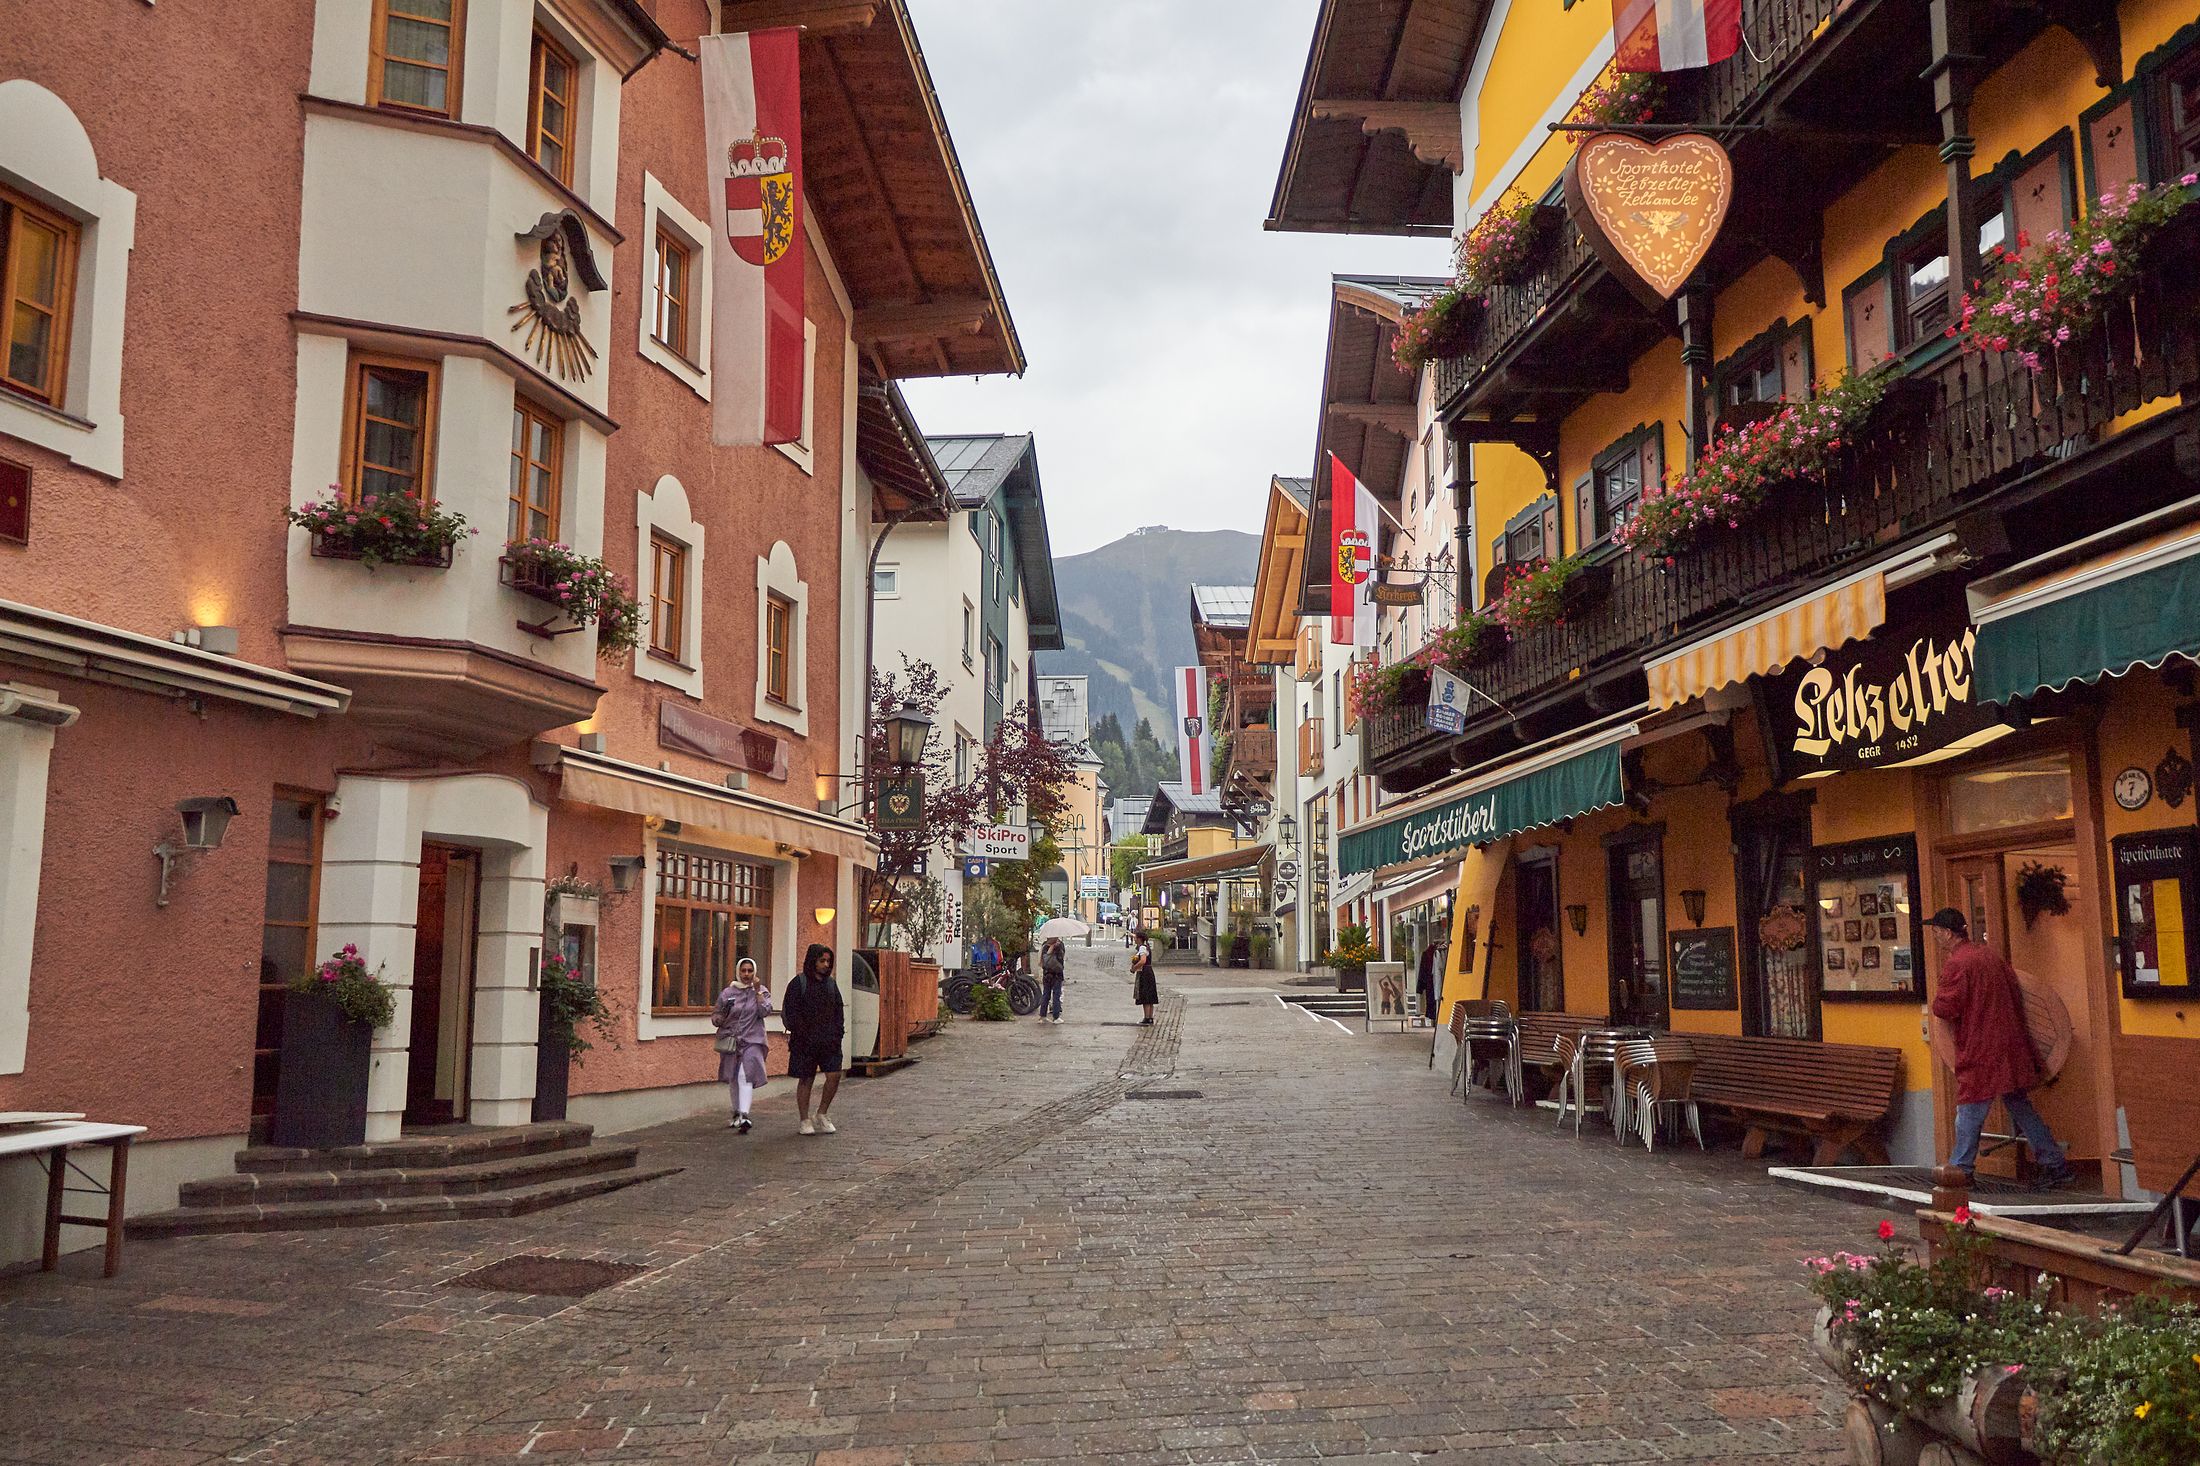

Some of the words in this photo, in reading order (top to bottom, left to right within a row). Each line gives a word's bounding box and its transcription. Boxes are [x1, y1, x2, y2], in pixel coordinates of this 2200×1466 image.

[1610, 158, 1703, 178] Sporthotel
[1616, 174, 1698, 193] Lebzelter
[1618, 190, 1653, 206] Zell
[1652, 197, 1672, 206] am
[1671, 190, 1699, 206] See
[672, 715, 711, 746] Historic
[715, 729, 755, 759] Boutique
[1858, 745, 1881, 759] GEGR
[2128, 781, 2135, 797] 7
[977, 827, 1026, 843] SkiPro
[1402, 794, 1497, 859] Sportstüberl
[985, 843, 1018, 855] Sport
[953, 901, 962, 938] Rent
